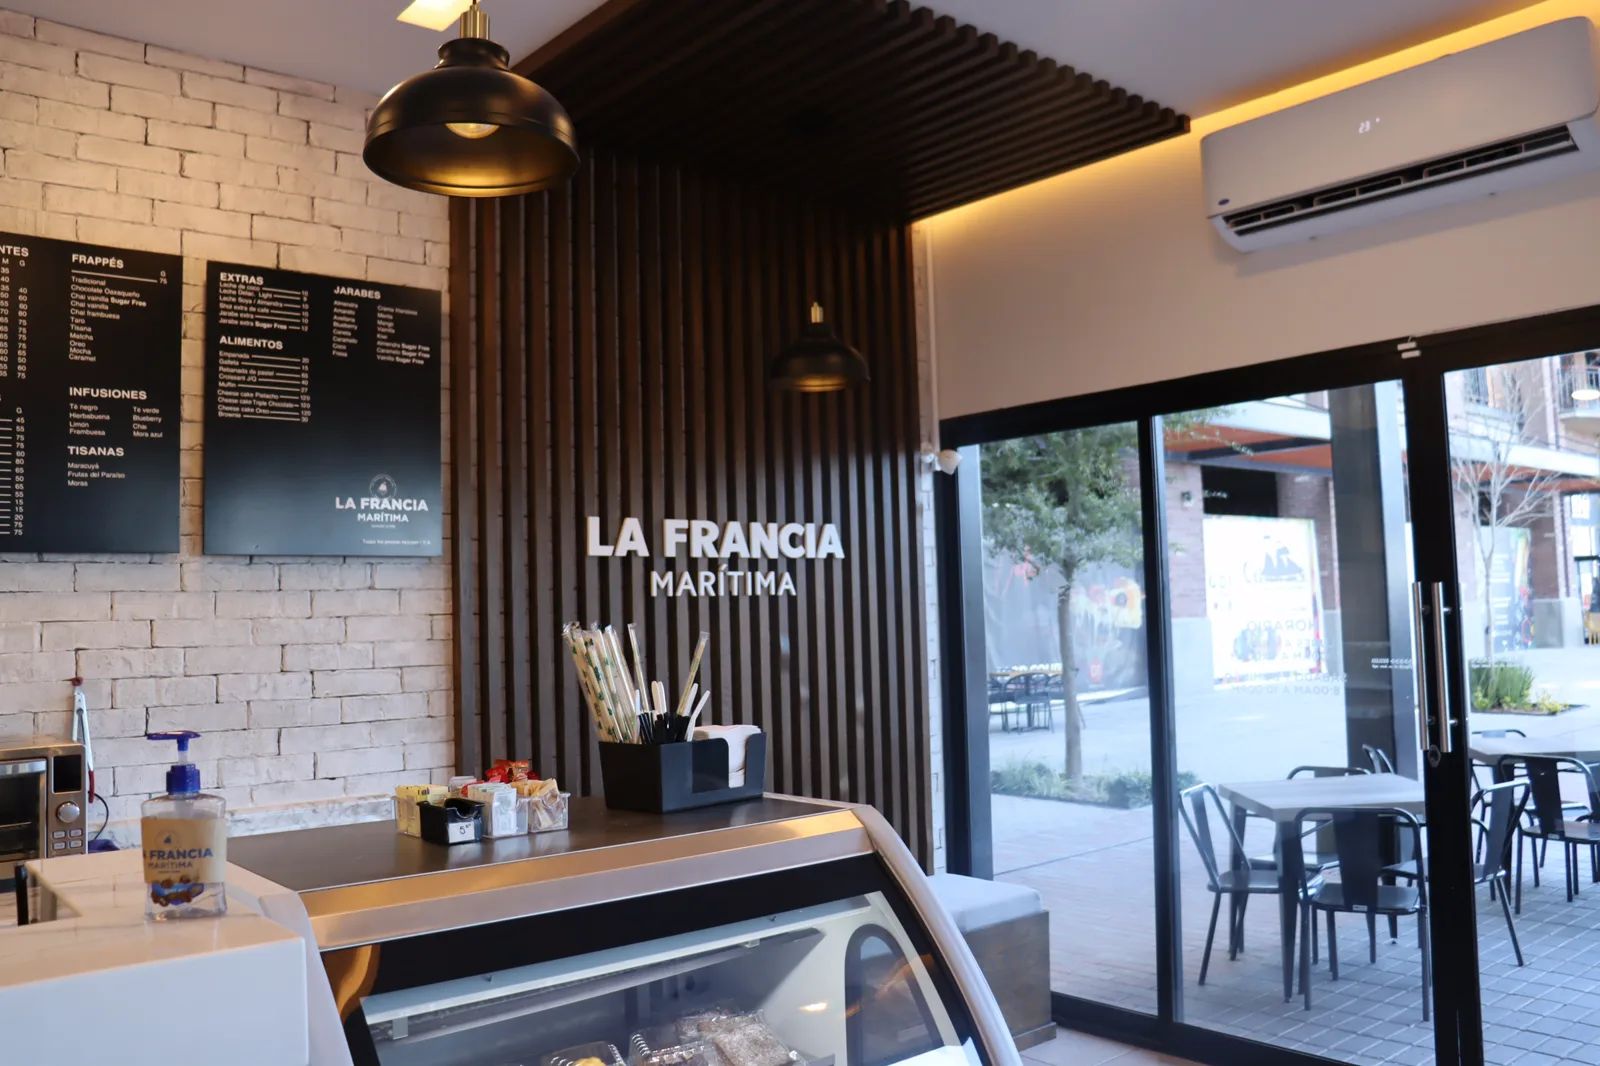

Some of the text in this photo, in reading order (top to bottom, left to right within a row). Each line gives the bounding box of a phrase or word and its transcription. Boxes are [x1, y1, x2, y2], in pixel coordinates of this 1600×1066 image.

[1358, 120, 1370, 134] 23
[72, 253, 124, 269] FRAPPÉS
[71, 276, 106, 286] Tradicional
[220, 272, 264, 286] EXTRAS
[70, 284, 140, 298] Chocolate Oaxaqueño
[334, 286, 381, 300] JARABES
[110, 297, 130, 306] Sugar
[132, 299, 147, 307] Free
[70, 308, 120, 320] Chai frambuesa
[70, 324, 92, 332] Tisana
[70, 332, 94, 340] Matcha
[220, 335, 283, 350] ALIMENTOS
[68, 353, 96, 362] Caramel
[69, 387, 147, 400] INFUSIONES
[69, 412, 110, 420] Hierbabuena
[133, 414, 162, 423] Blueberry
[69, 428, 106, 436] Frambuesa
[67, 446, 124, 456] TISANAS
[335, 496, 429, 512] LA FRANCIA
[357, 511, 409, 523] MARÍTIMA
[586, 516, 845, 560] LA FRANCIA
[650, 564, 797, 597] MARÍTIMA
[150, 848, 214, 860] FRANCIA
